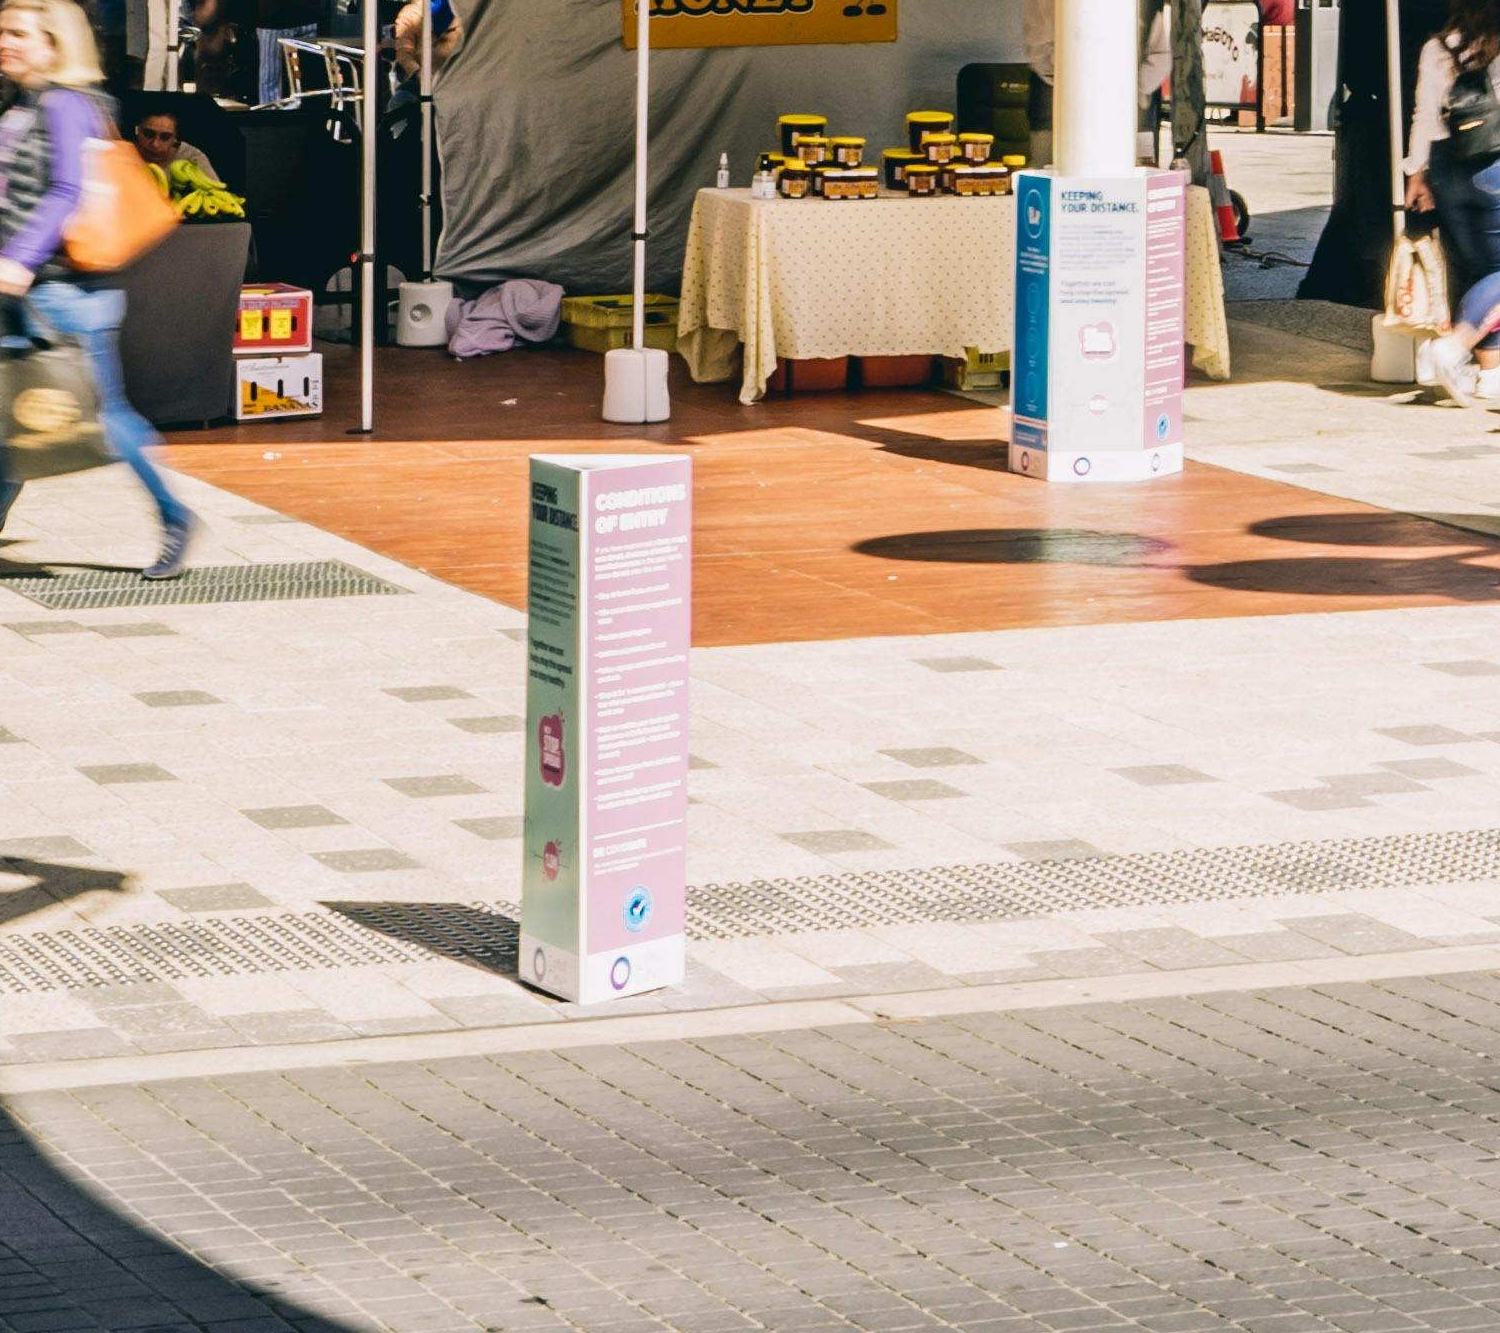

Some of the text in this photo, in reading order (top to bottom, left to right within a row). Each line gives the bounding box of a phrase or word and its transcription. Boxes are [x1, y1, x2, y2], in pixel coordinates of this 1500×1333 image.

[1060, 191, 1103, 202] KEEPING
[1060, 203, 1087, 213] YOUR
[595, 484, 687, 511] CONDITIONS
[595, 508, 669, 534] OF ENTRY
